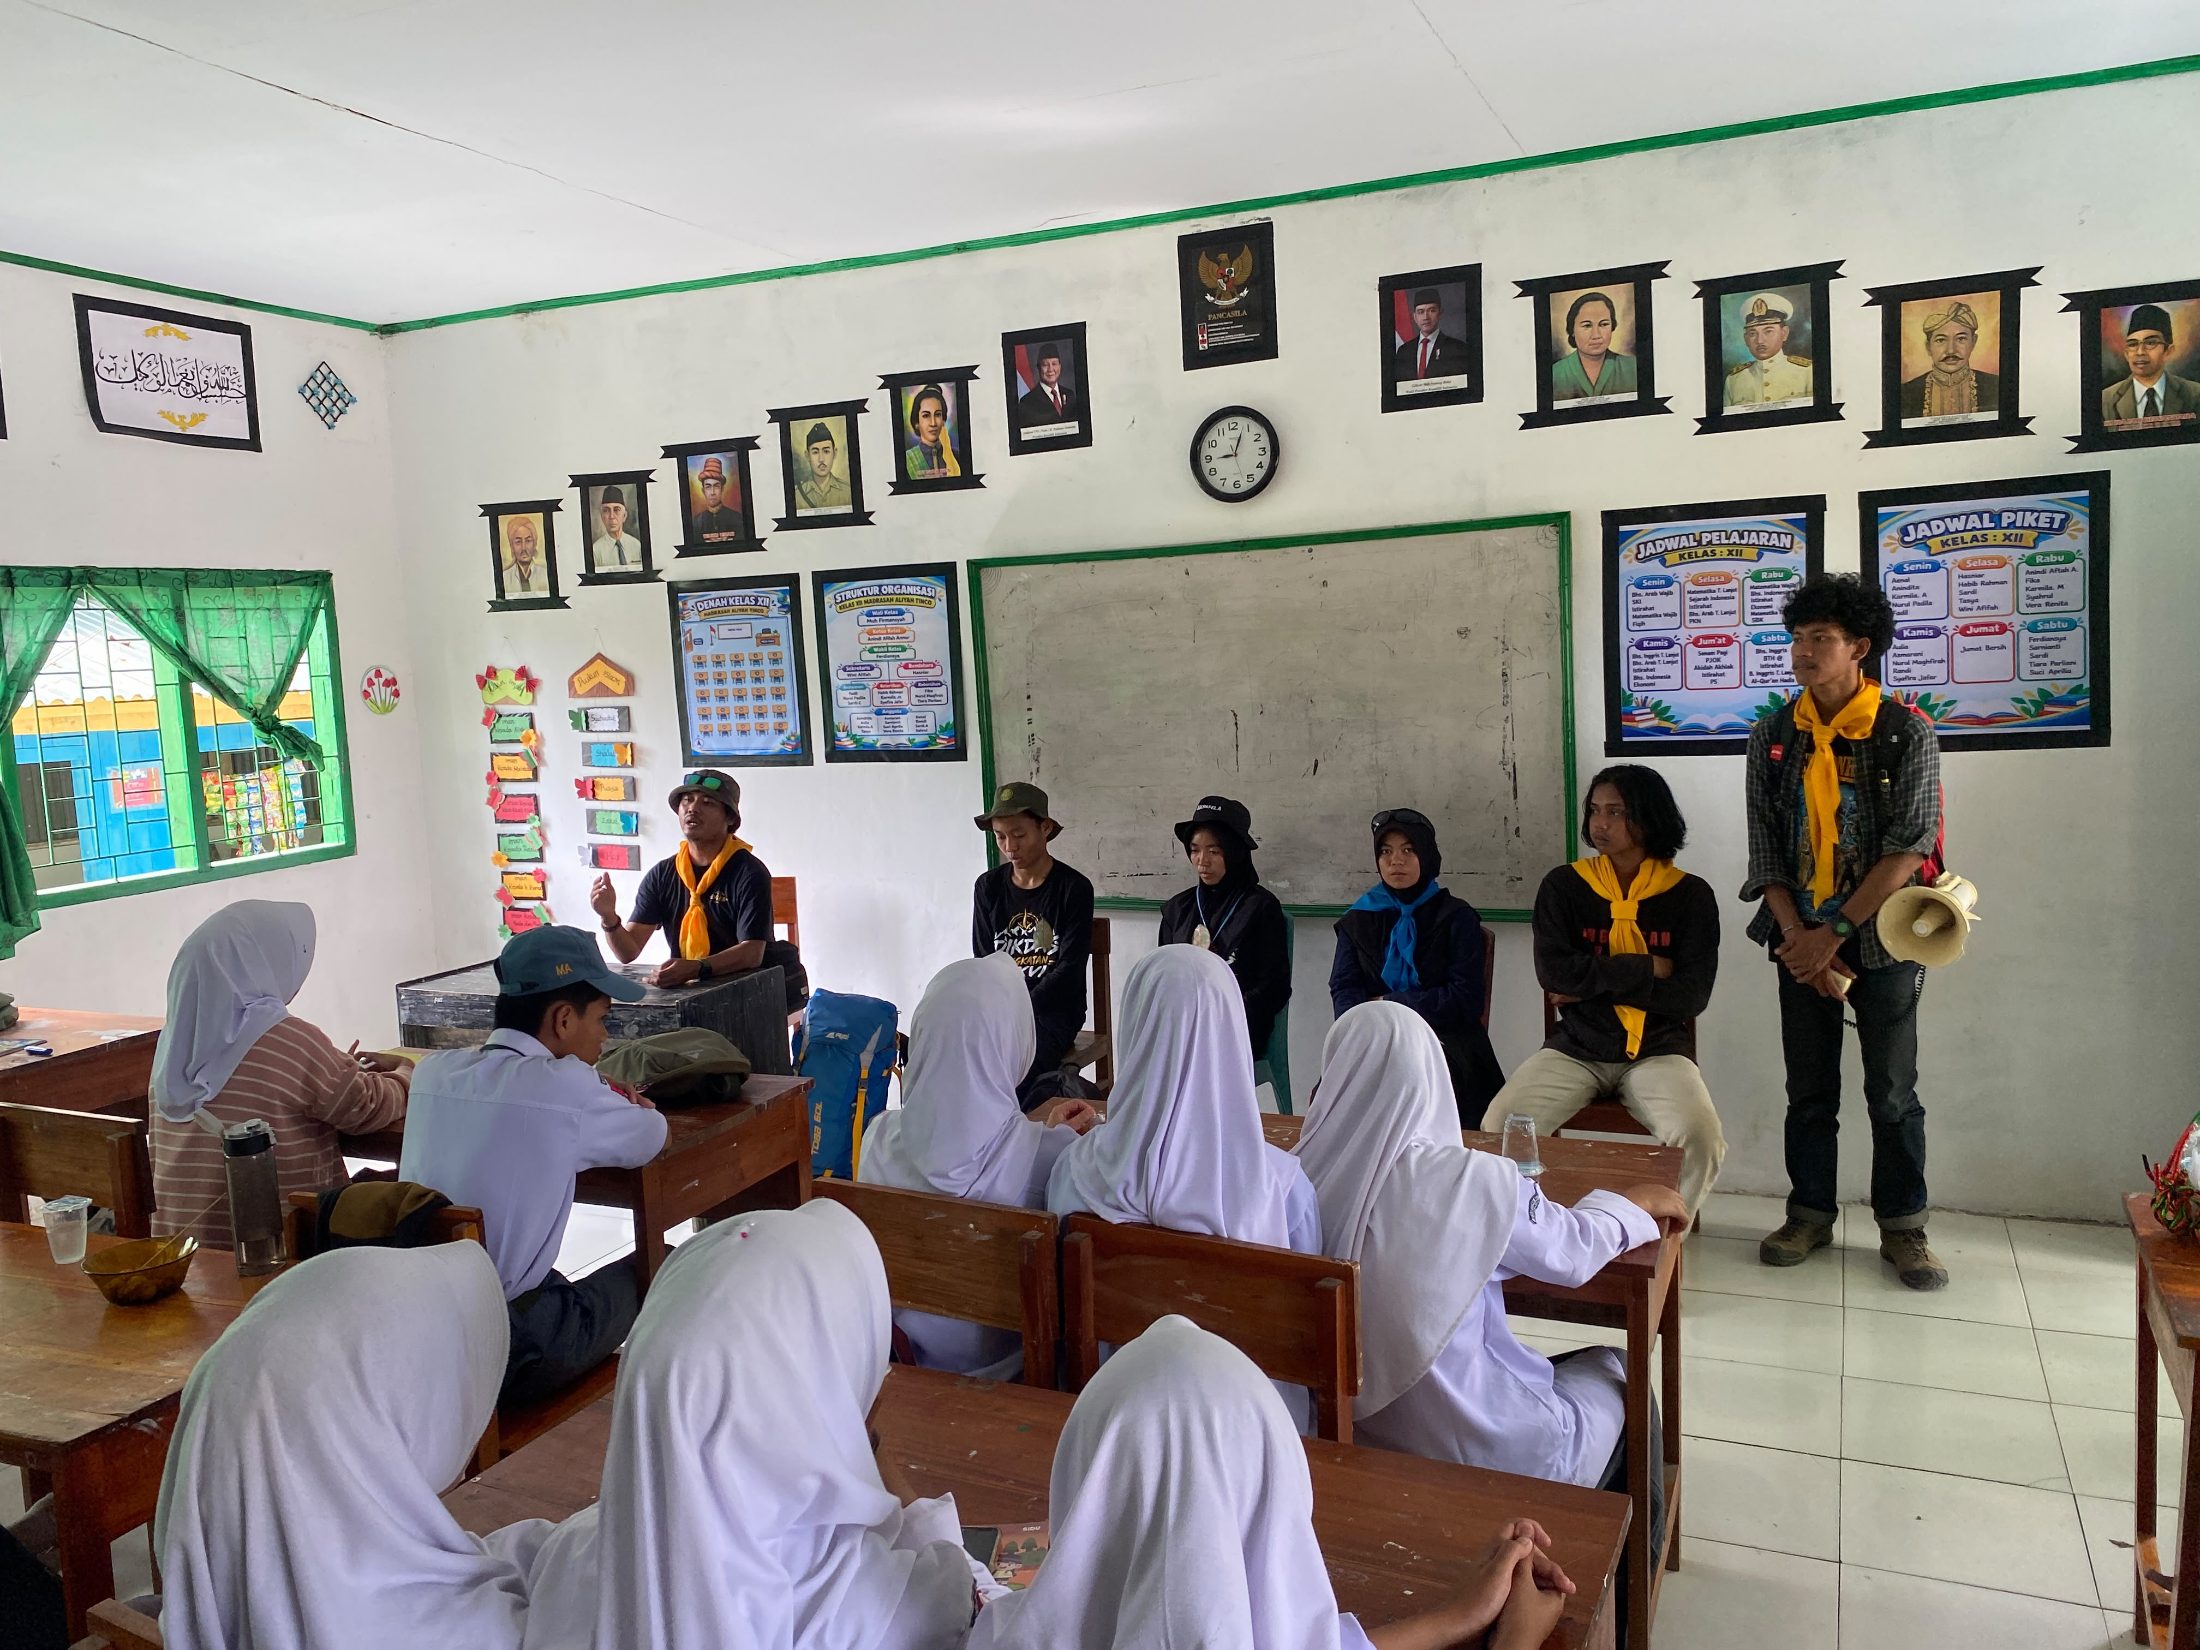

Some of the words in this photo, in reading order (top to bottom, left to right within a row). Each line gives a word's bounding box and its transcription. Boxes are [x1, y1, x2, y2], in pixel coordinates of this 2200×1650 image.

[1208, 310, 1247, 320] PANCASILA
[1228, 422, 1238, 431] 12
[1218, 428, 1224, 436] 11
[1254, 434, 1261, 442] 2
[1208, 440, 1217, 448] 10
[1258, 447, 1266, 456] 3
[1205, 455, 1212, 463] 9
[1256, 461, 1263, 469] 4
[1209, 468, 1217, 476] 8
[1220, 478, 1227, 486] 7
[1246, 474, 1254, 483] 5
[1233, 480, 1241, 488] 6
[1903, 513, 1995, 542] JADWAL
[2001, 511, 2066, 529] PIKET
[1940, 534, 1987, 548] KELAS
[2002, 533, 2023, 543] XII
[1638, 534, 1697, 559] JADWAL
[1701, 531, 1794, 549] PELAJARAN
[1679, 549, 1717, 561] KELAS
[1726, 549, 1743, 558] XII
[2036, 555, 2064, 563] Rabu
[1903, 563, 1932, 571] Senin
[1966, 559, 1999, 568] Selasa
[1698, 575, 1725, 583] Selasa
[1761, 571, 1784, 579] Rabu
[1642, 578, 1665, 586] Senin
[835, 586, 880, 602] STRUKTUR
[881, 585, 935, 597] ORGANISASI
[696, 597, 728, 611] DENAH
[729, 596, 755, 607] KELAS
[757, 597, 770, 606] XII
[839, 602, 855, 610] KELAS
[863, 598, 894, 606] MADRASAH
[1958, 597, 1979, 605] Tasya
[2037, 620, 2068, 630] Sabtu
[1903, 628, 1934, 638] Kamis
[1966, 625, 2000, 634] Jumat
[1698, 637, 1726, 645] Jum'at
[1760, 634, 1786, 642] Sabtu
[1643, 640, 1669, 648] Kamis
[555, 963, 573, 976] MA
